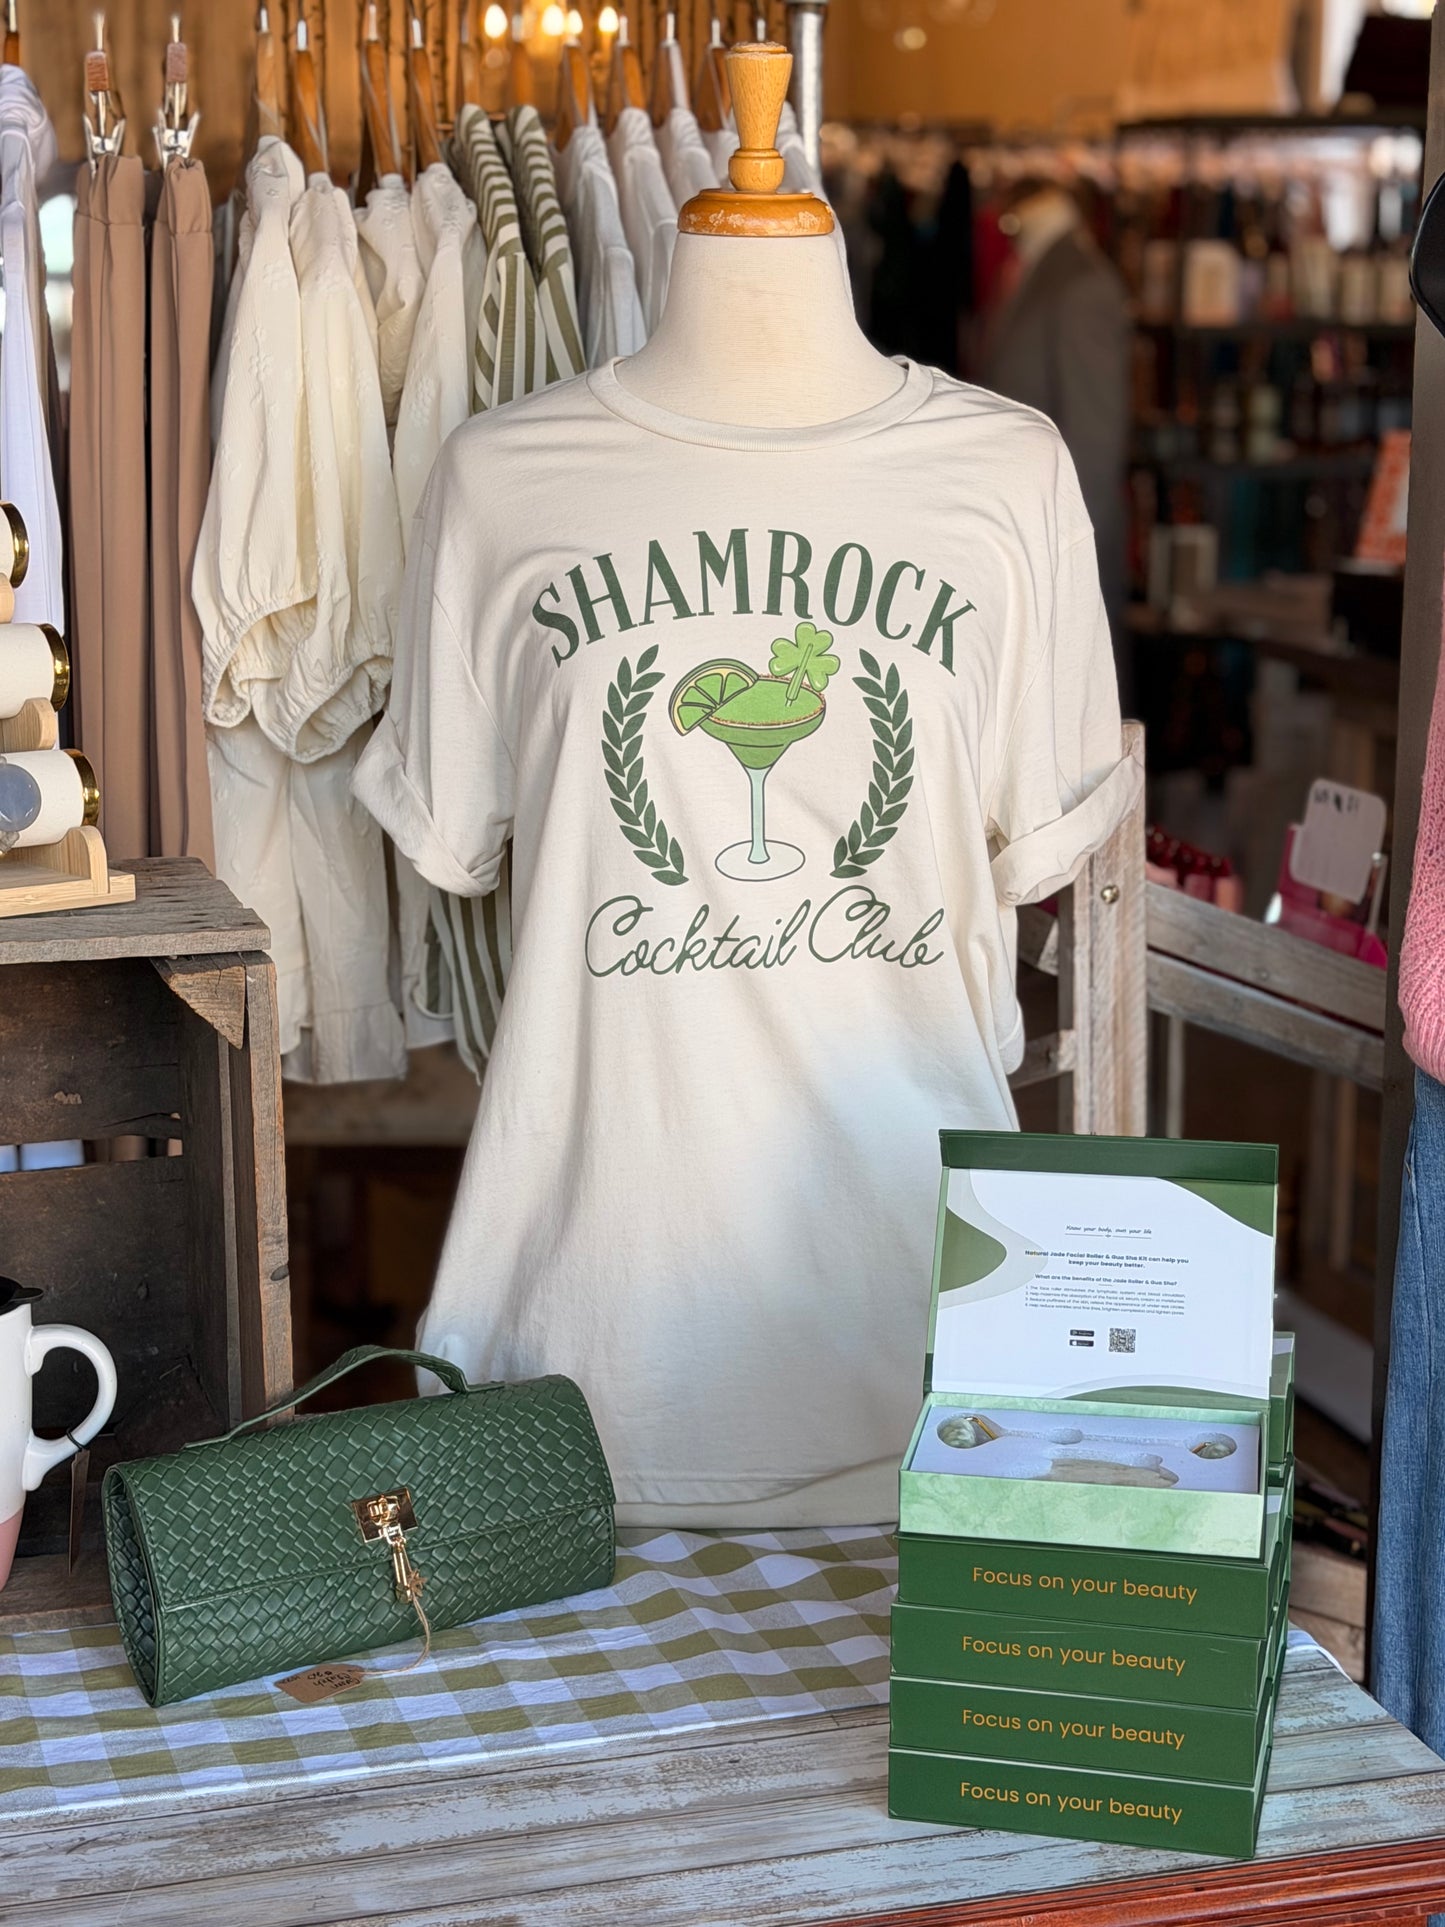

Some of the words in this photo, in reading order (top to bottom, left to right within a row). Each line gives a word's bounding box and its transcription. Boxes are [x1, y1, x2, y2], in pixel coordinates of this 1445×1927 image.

[532, 528, 977, 676] SHAMROCK
[585, 895, 812, 977] Cocktail
[808, 885, 944, 969] Club
[973, 1567, 1032, 1587] Focus
[1038, 1575, 1064, 1590] on
[1071, 1579, 1117, 1595] your
[1123, 1579, 1197, 1605] beauty
[962, 1635, 1021, 1657] Focus
[1027, 1645, 1053, 1659] on
[1059, 1648, 1105, 1665] your
[1111, 1650, 1185, 1676] beauty
[962, 1709, 1021, 1730] Focus
[1027, 1718, 1053, 1733] on
[1059, 1722, 1105, 1738] your
[1111, 1724, 1185, 1751] beauty
[960, 1781, 1020, 1803] Focus
[1025, 1792, 1051, 1806] on
[1057, 1795, 1103, 1812] your
[1109, 1798, 1183, 1825] beauty
